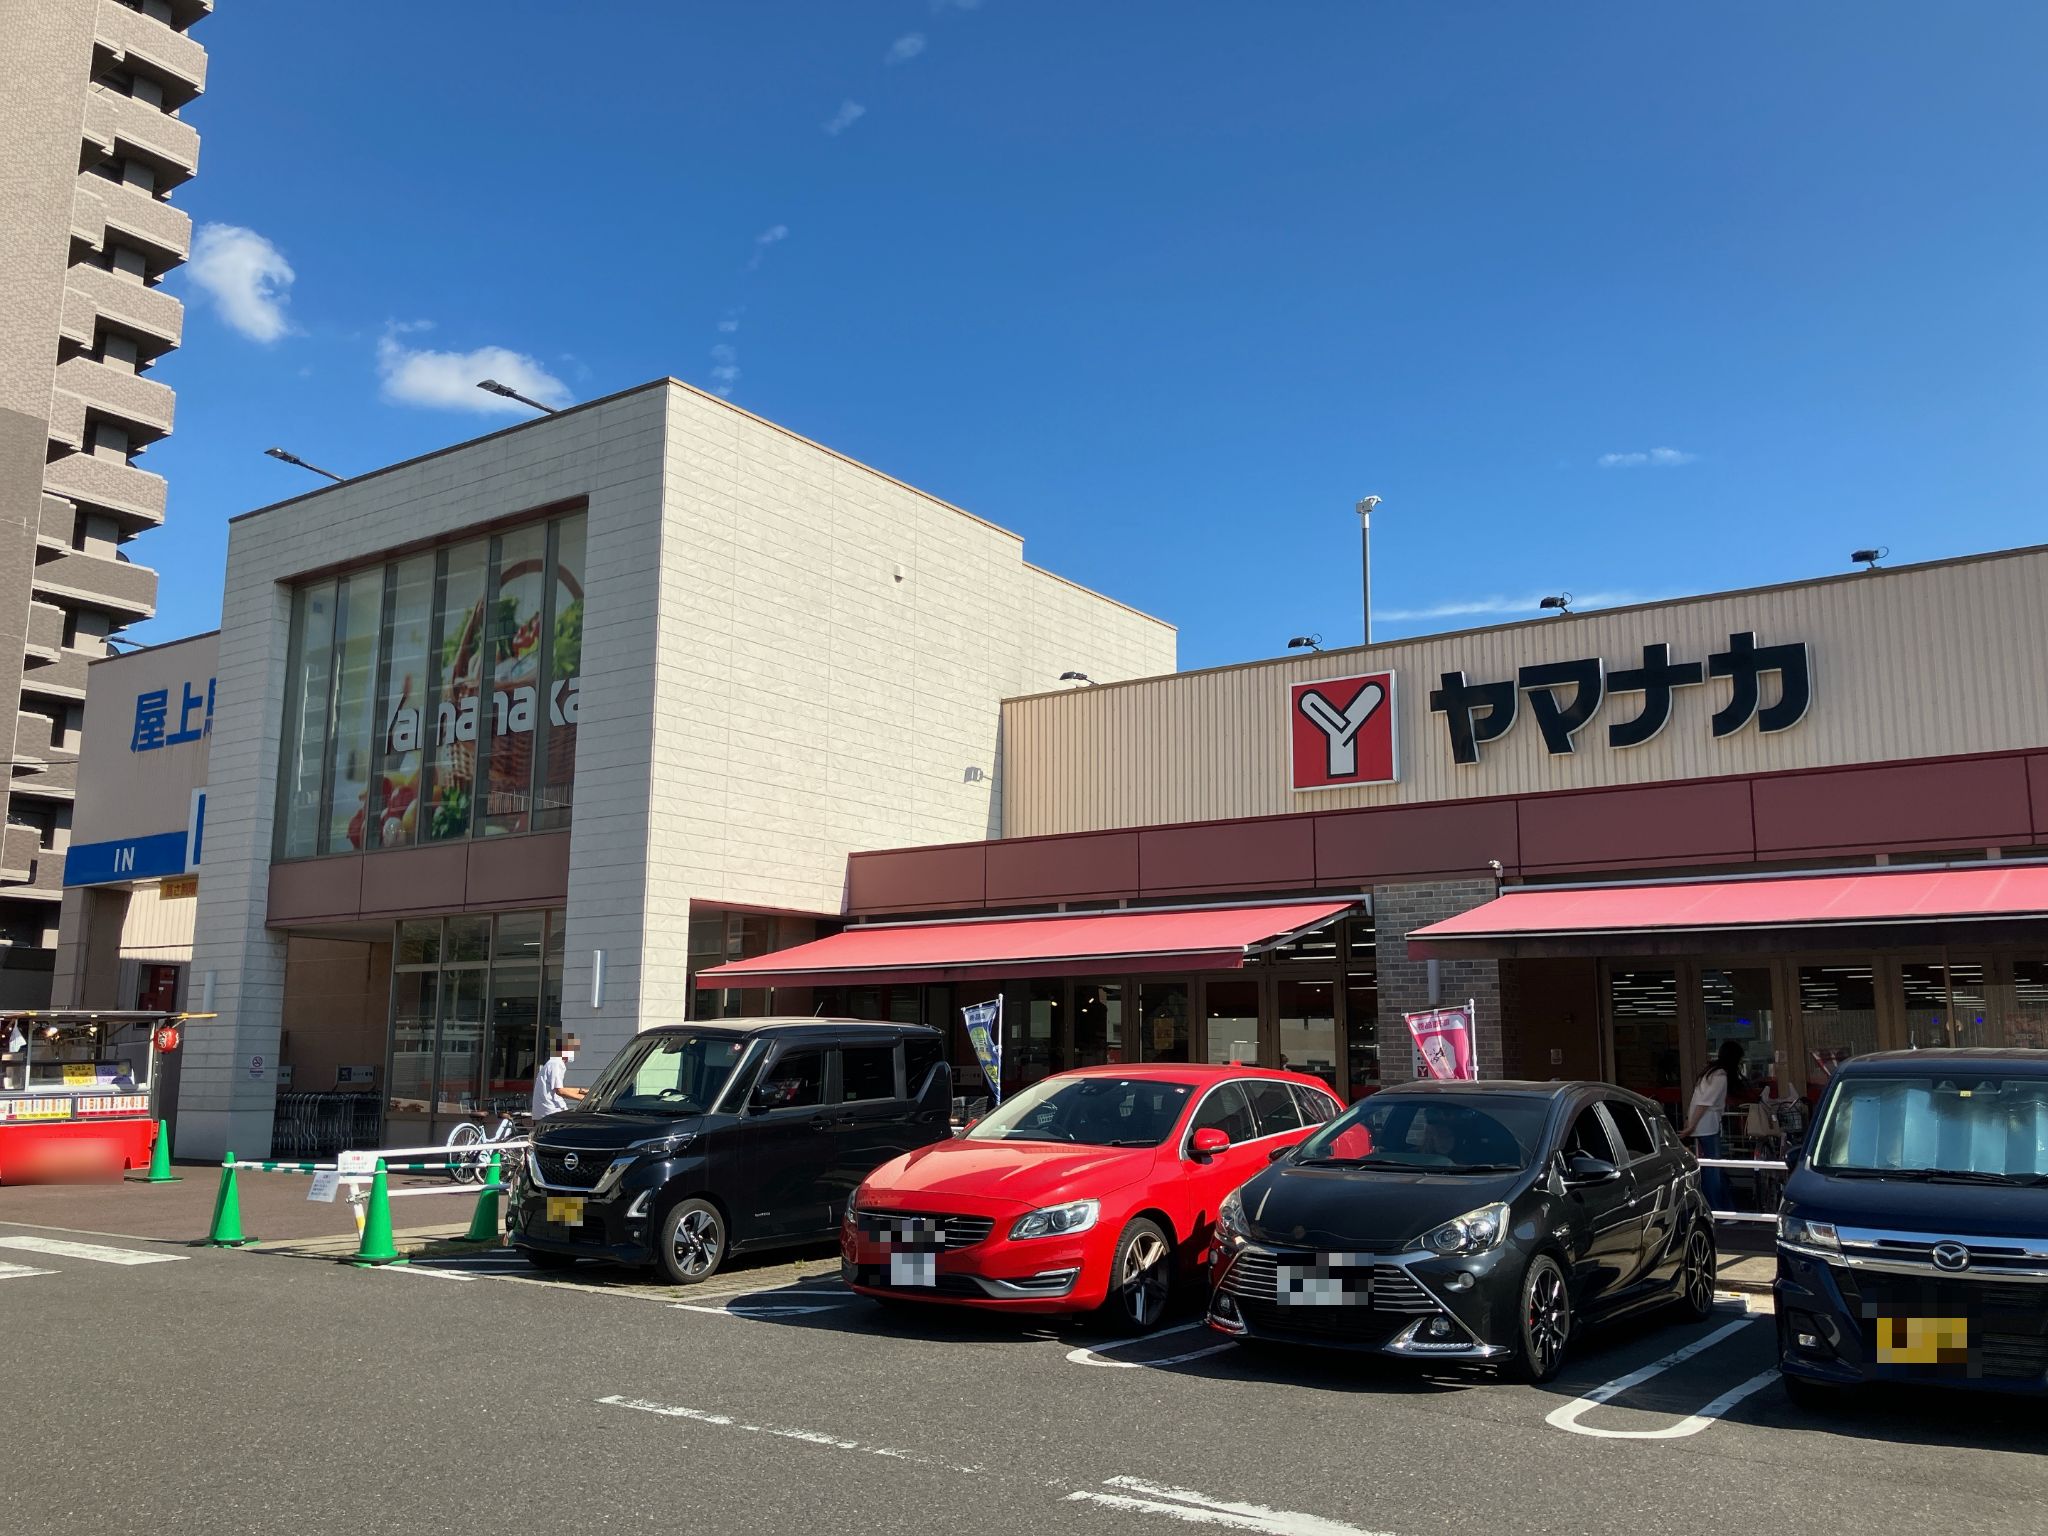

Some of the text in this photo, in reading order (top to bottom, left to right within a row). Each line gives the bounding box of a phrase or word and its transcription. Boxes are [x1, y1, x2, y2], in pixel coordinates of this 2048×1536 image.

[1429, 631, 1812, 765] ヤマナカ
[113, 846, 136, 872] IN
